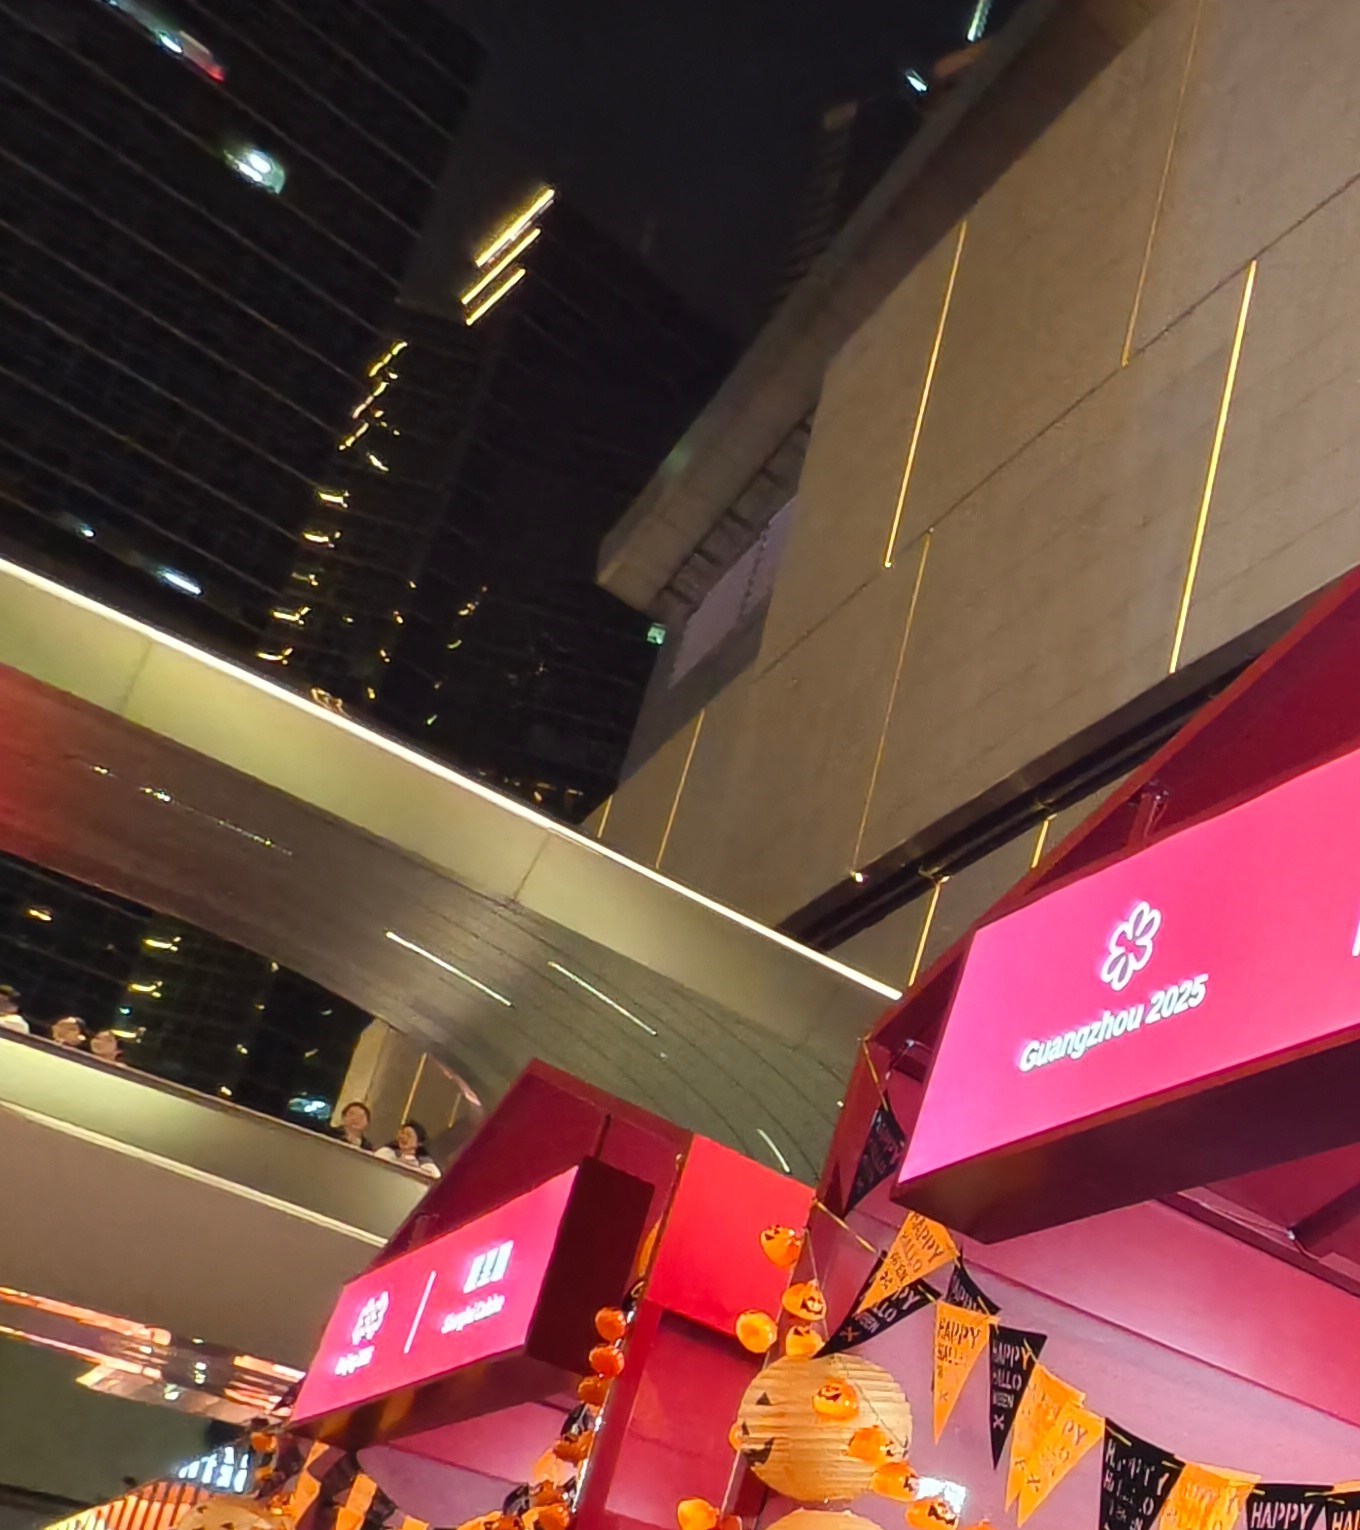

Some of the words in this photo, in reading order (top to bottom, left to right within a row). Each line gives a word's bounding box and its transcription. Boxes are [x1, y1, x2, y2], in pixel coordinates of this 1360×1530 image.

[1019, 1004, 1144, 1072] Guangzhou
[1145, 973, 1209, 1024] 2025
[1250, 1501, 1315, 1530] HAPPY
